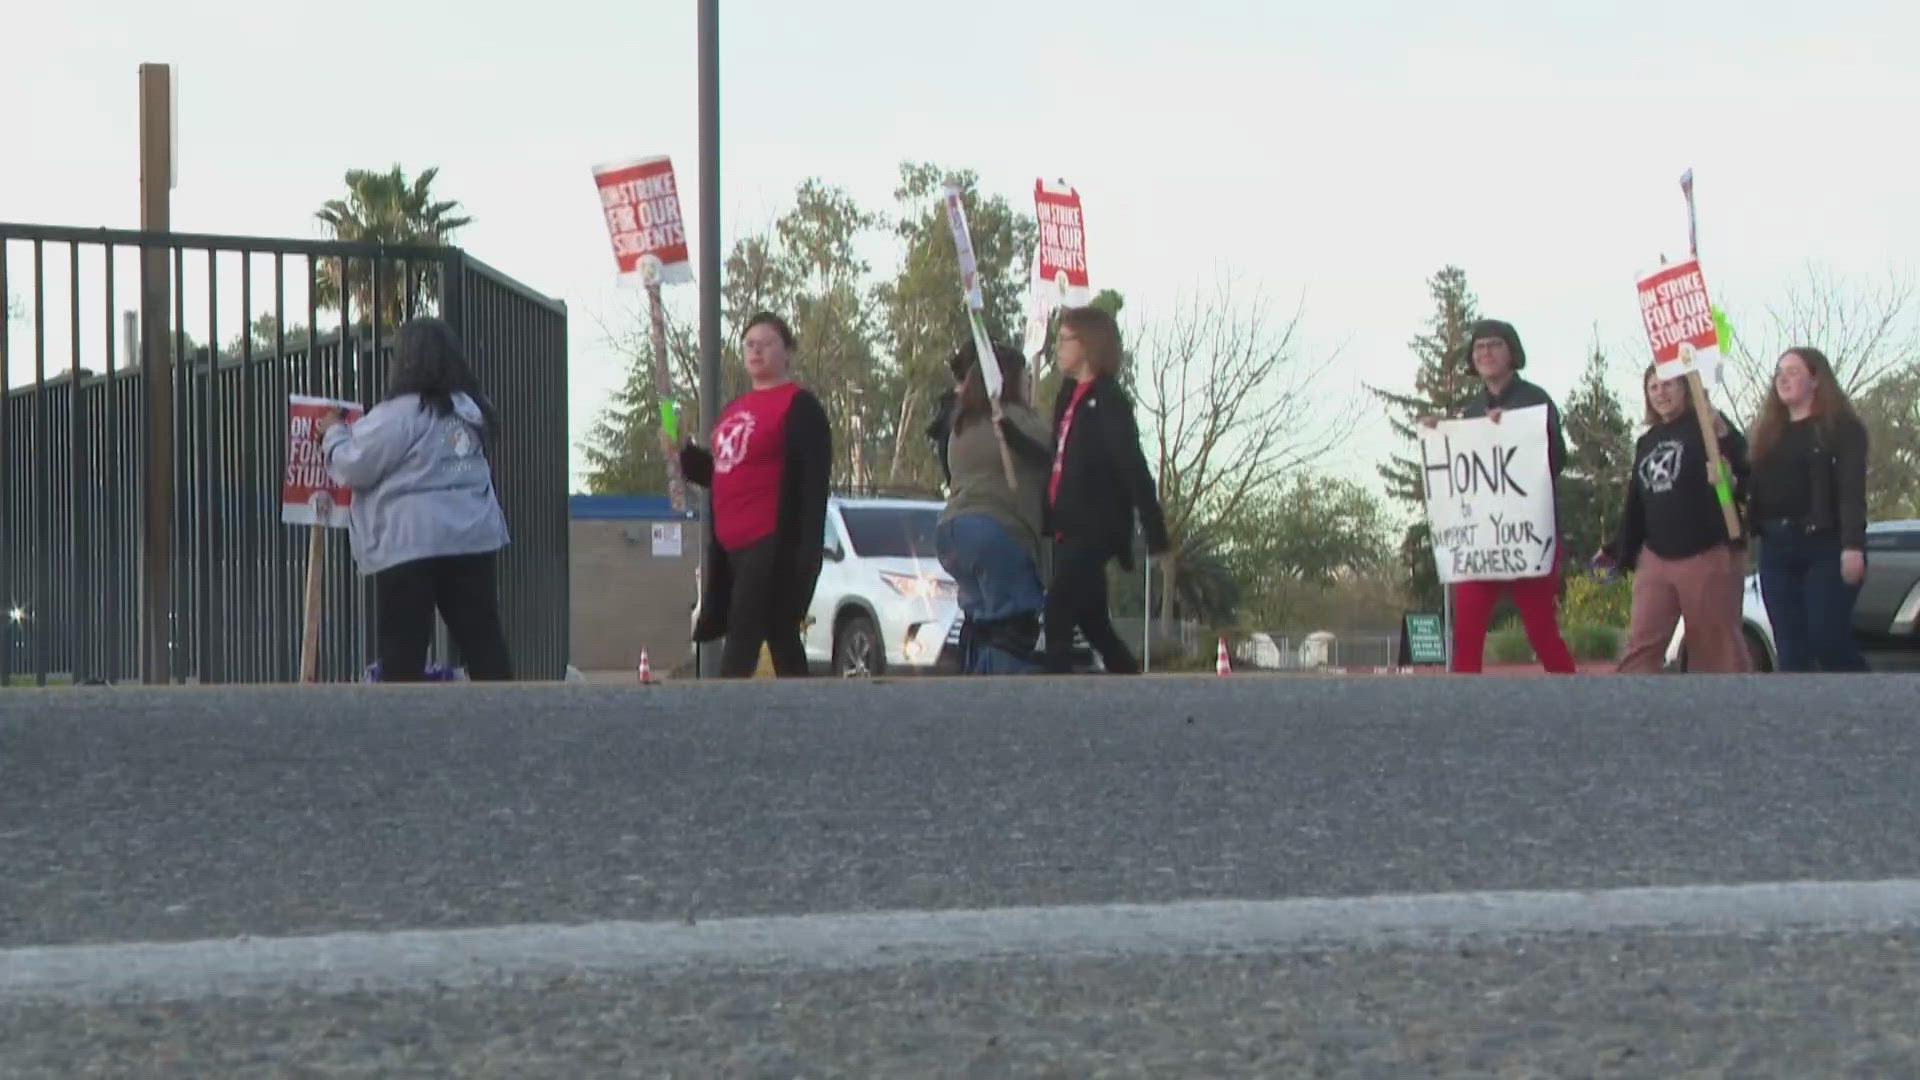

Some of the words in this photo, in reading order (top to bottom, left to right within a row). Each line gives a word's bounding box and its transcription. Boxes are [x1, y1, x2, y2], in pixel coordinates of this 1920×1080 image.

[618, 172, 677, 206] STRIKE
[637, 194, 681, 229] OUR
[1051, 203, 1081, 227] STRIKE
[612, 221, 686, 257] STUDENTS
[1041, 221, 1059, 247] FOR
[1059, 223, 1083, 251] OUR
[1042, 246, 1085, 272] STUDENTS
[1656, 271, 1702, 303] STRIKE
[1672, 290, 1709, 319] OUR
[1650, 313, 1714, 352] STUDENTS
[290, 415, 312, 440] ON
[1421, 434, 1528, 499] HONK
